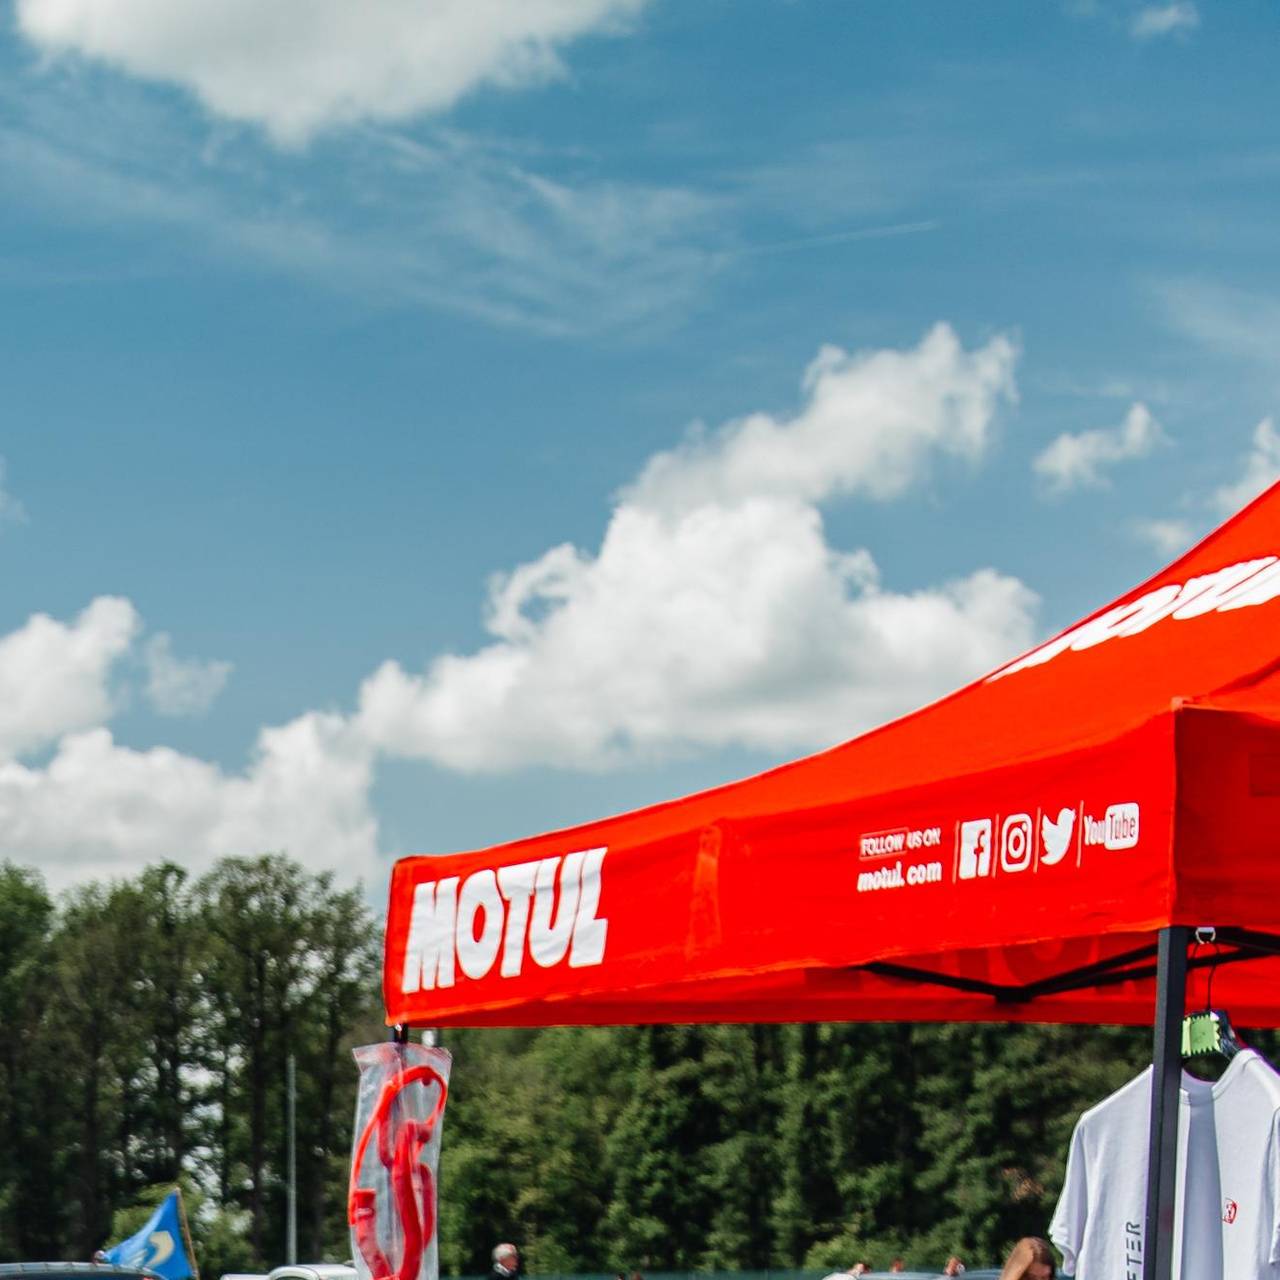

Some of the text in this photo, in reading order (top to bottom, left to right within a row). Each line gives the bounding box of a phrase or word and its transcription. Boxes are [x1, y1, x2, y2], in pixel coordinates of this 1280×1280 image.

[860, 827, 941, 857] FOLLOW US ON
[402, 847, 609, 993] MOTUL
